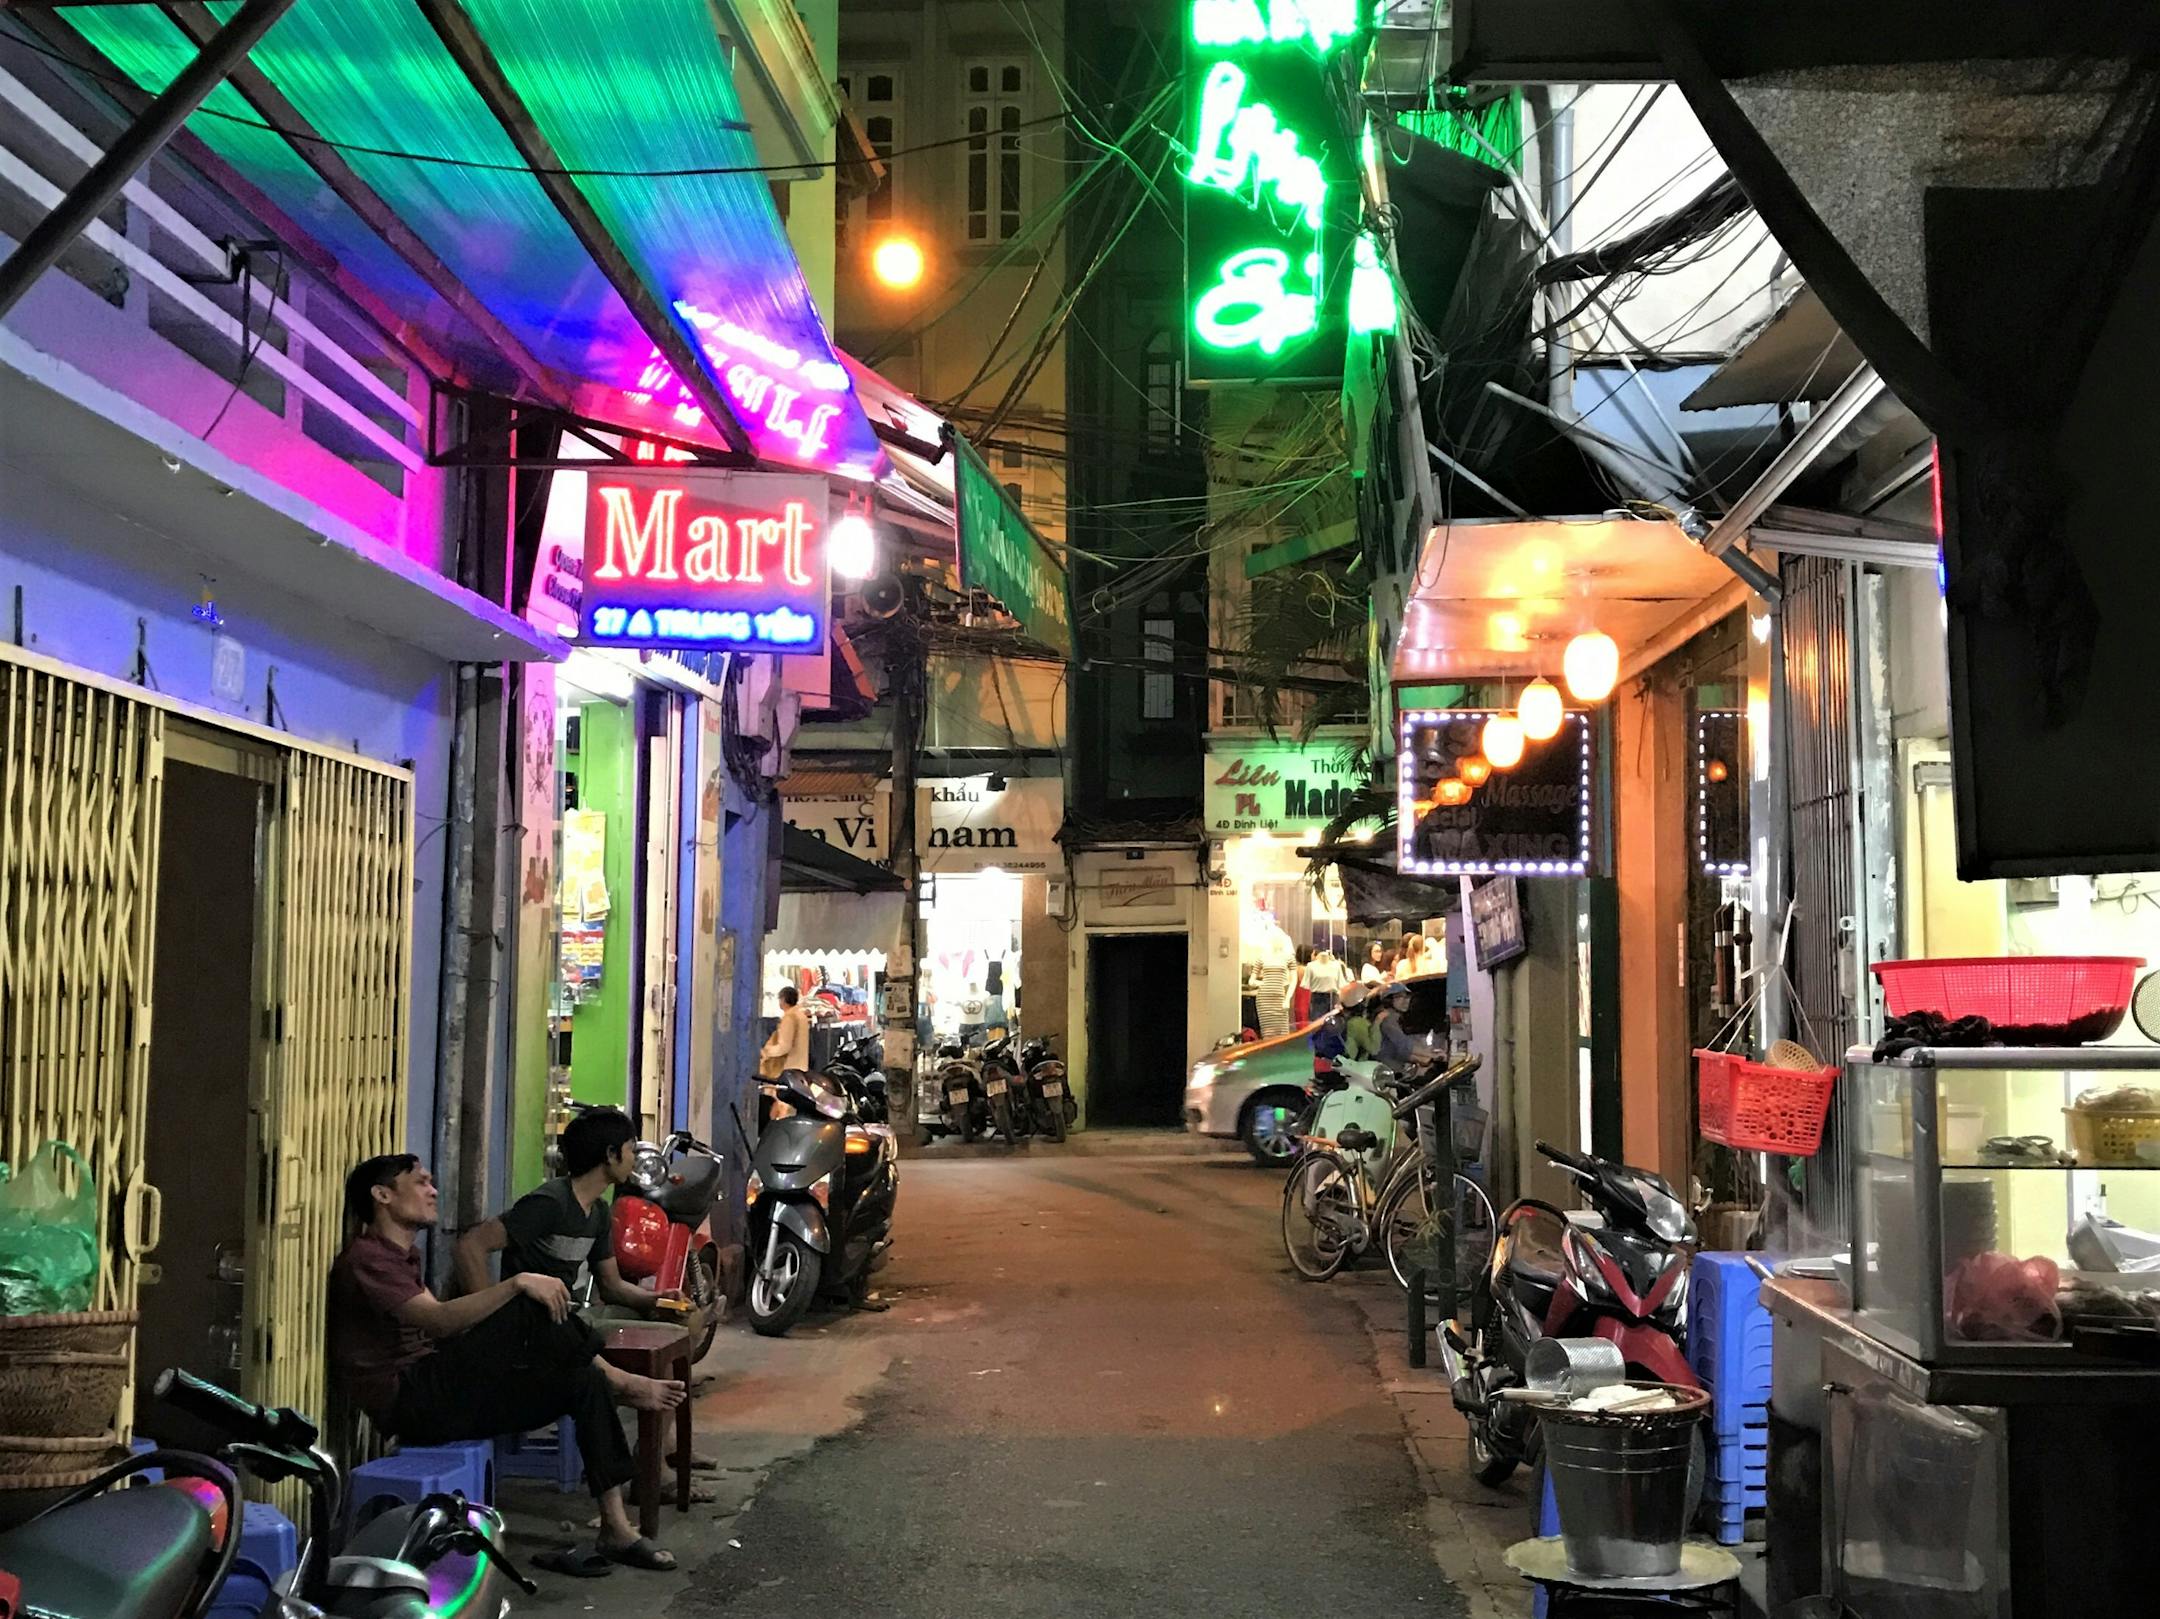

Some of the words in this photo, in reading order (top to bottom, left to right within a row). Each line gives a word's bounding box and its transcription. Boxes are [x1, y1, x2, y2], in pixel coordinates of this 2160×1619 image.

[594, 487, 814, 587] Mart
[594, 606, 627, 636] 27
[654, 608, 750, 641] TRUNG
[931, 782, 980, 802] khẩu
[1481, 774, 1579, 815] Massage
[1429, 830, 1570, 860] WAXING
